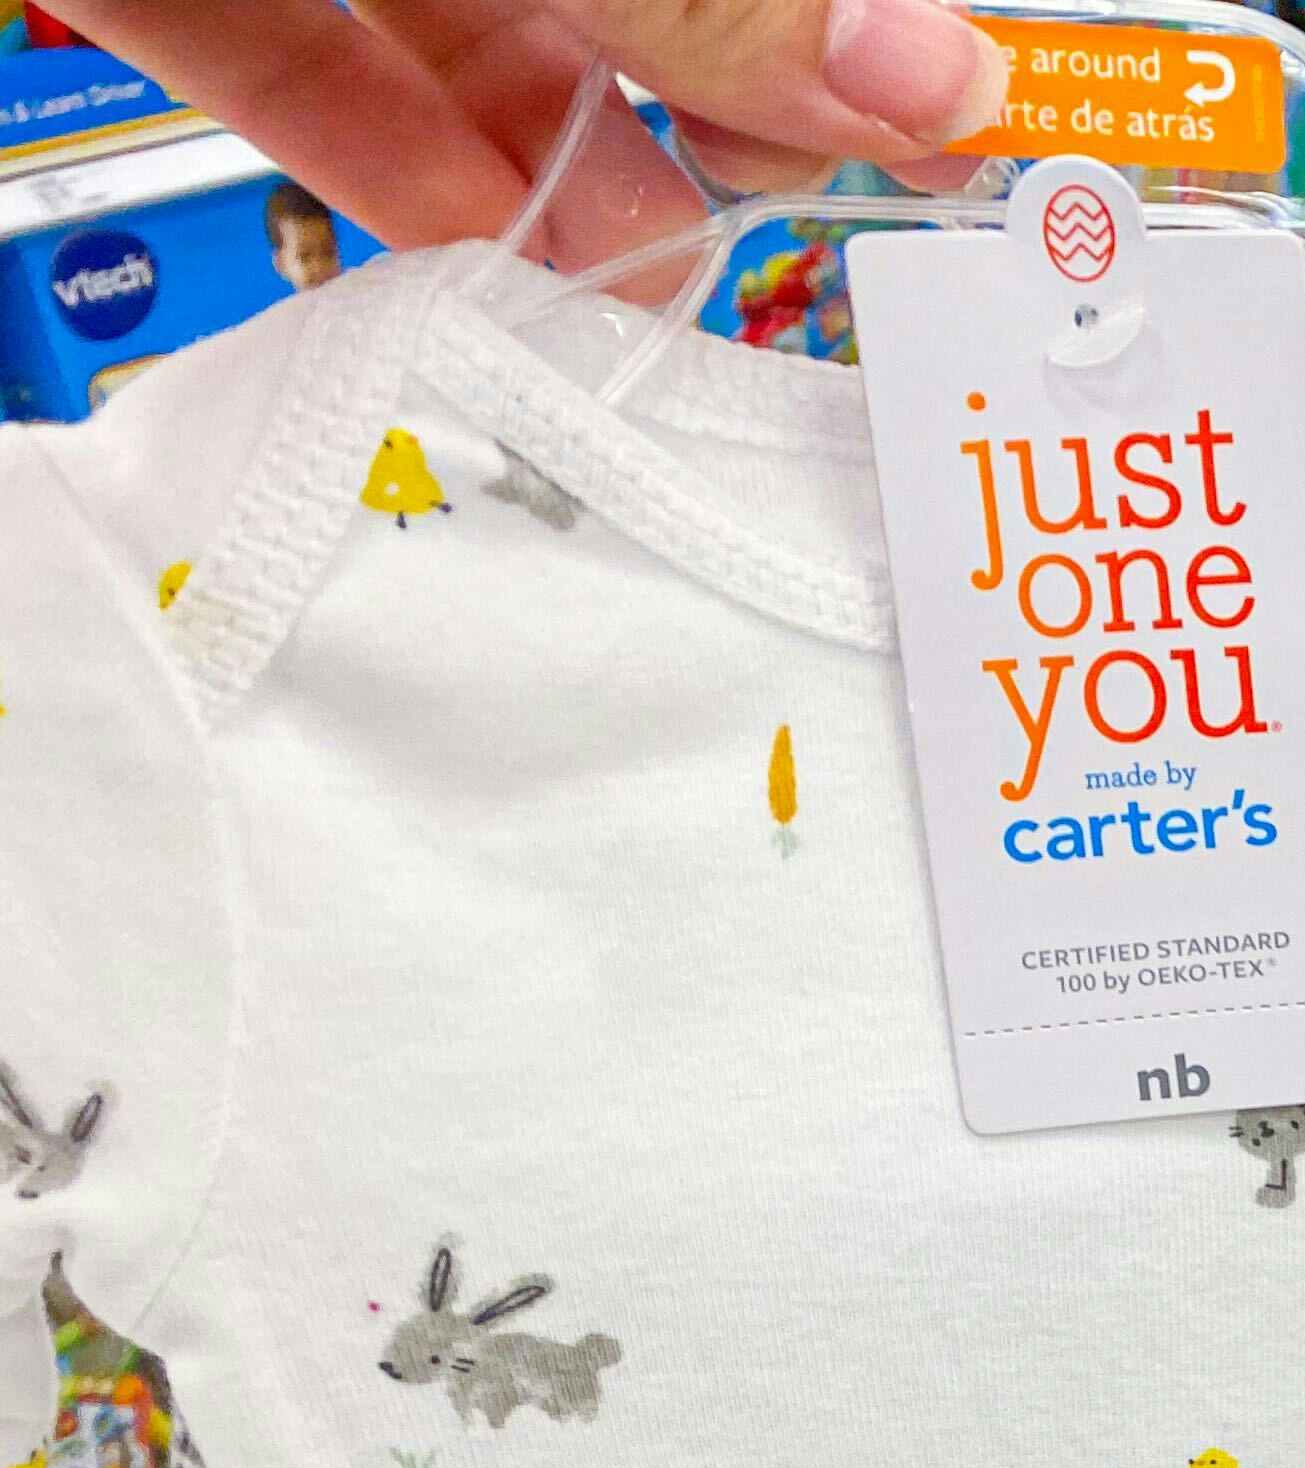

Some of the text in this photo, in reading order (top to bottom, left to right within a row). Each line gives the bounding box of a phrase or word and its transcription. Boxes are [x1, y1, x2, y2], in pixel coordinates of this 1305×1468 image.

[1032, 47, 1161, 82] around
[1071, 99, 1114, 134] de
[1126, 106, 1215, 142] atrás
[960, 391, 1247, 591] just
[1018, 546, 1255, 638] one
[1085, 760, 1197, 790] made by
[1003, 788, 1278, 863] carter's
[1022, 931, 1291, 970] CERTIFIED STANDARD
[1056, 973, 1096, 993] 100
[1103, 970, 1130, 993] by
[1137, 1053, 1210, 1101] nb
